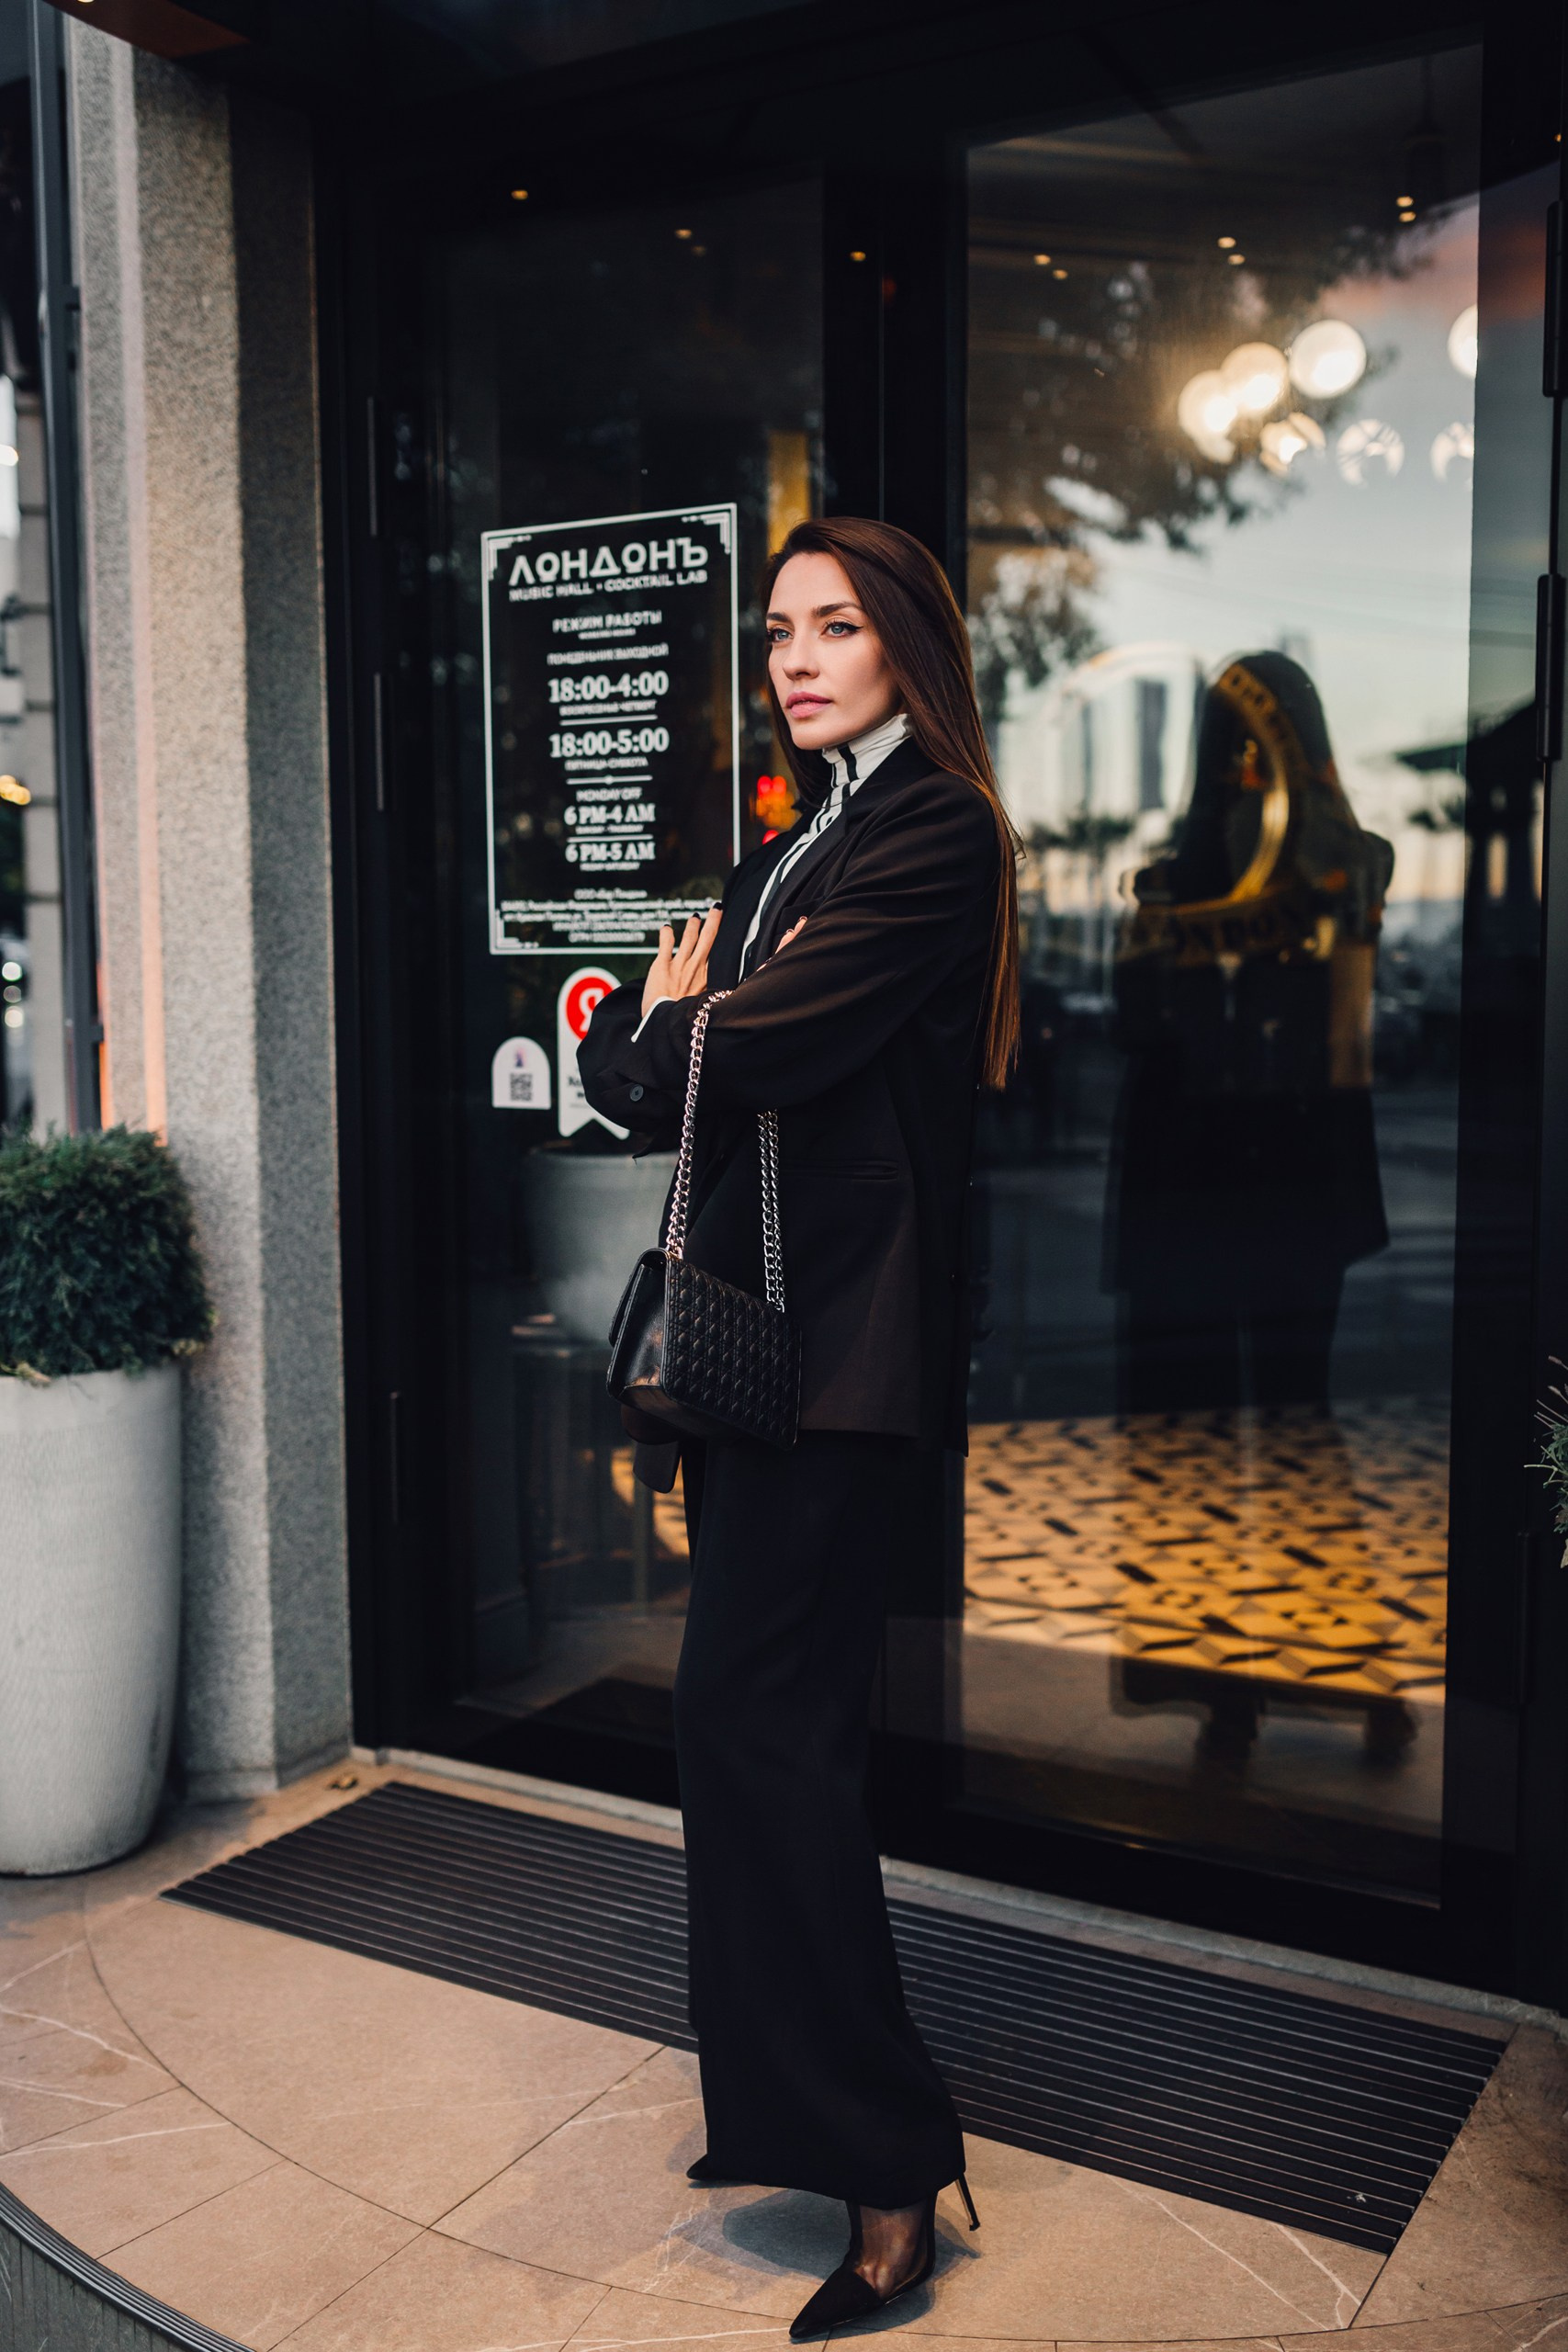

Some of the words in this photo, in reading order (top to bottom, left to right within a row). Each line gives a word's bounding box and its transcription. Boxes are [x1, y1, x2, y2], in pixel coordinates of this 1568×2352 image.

[509, 537, 709, 587] ЛОНДОНЪ
[509, 584, 554, 603] MUSIC
[556, 582, 594, 597] HALL
[604, 573, 674, 593] COCKTAIL
[676, 570, 708, 585] LAB
[552, 615, 604, 633] РЕЖИМ
[604, 609, 662, 628] РАБОТЫ
[547, 671, 670, 704] 18:00-4:00
[548, 726, 671, 759] 18:00-5:00
[563, 805, 578, 826] 6
[578, 804, 624, 824] PM-4
[624, 802, 656, 823] AM
[565, 842, 579, 863] 6
[579, 842, 624, 862] PM-5
[624, 840, 656, 861] AM
